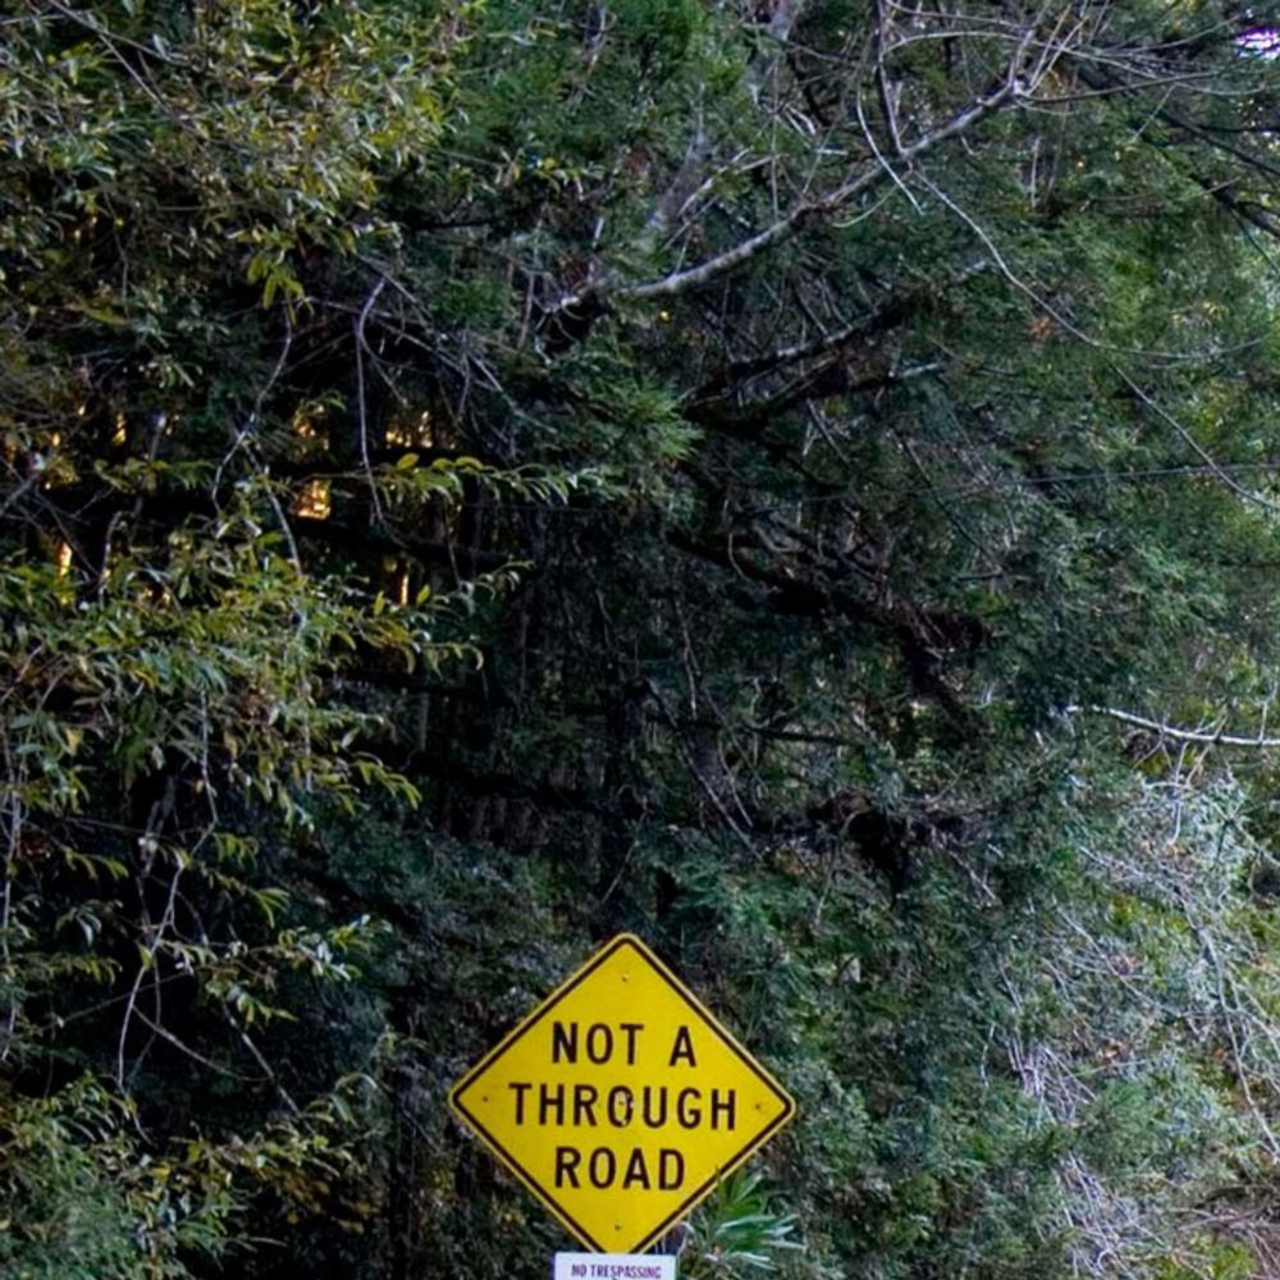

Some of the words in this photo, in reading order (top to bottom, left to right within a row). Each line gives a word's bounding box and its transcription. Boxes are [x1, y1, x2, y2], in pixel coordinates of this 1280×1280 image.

[552, 1021, 644, 1065] NOT
[669, 1026, 697, 1067] A
[509, 1083, 736, 1131] THROUGH
[555, 1146, 685, 1191] ROAD
[571, 1264, 587, 1277] NO
[590, 1264, 662, 1279] TRESPASSING
